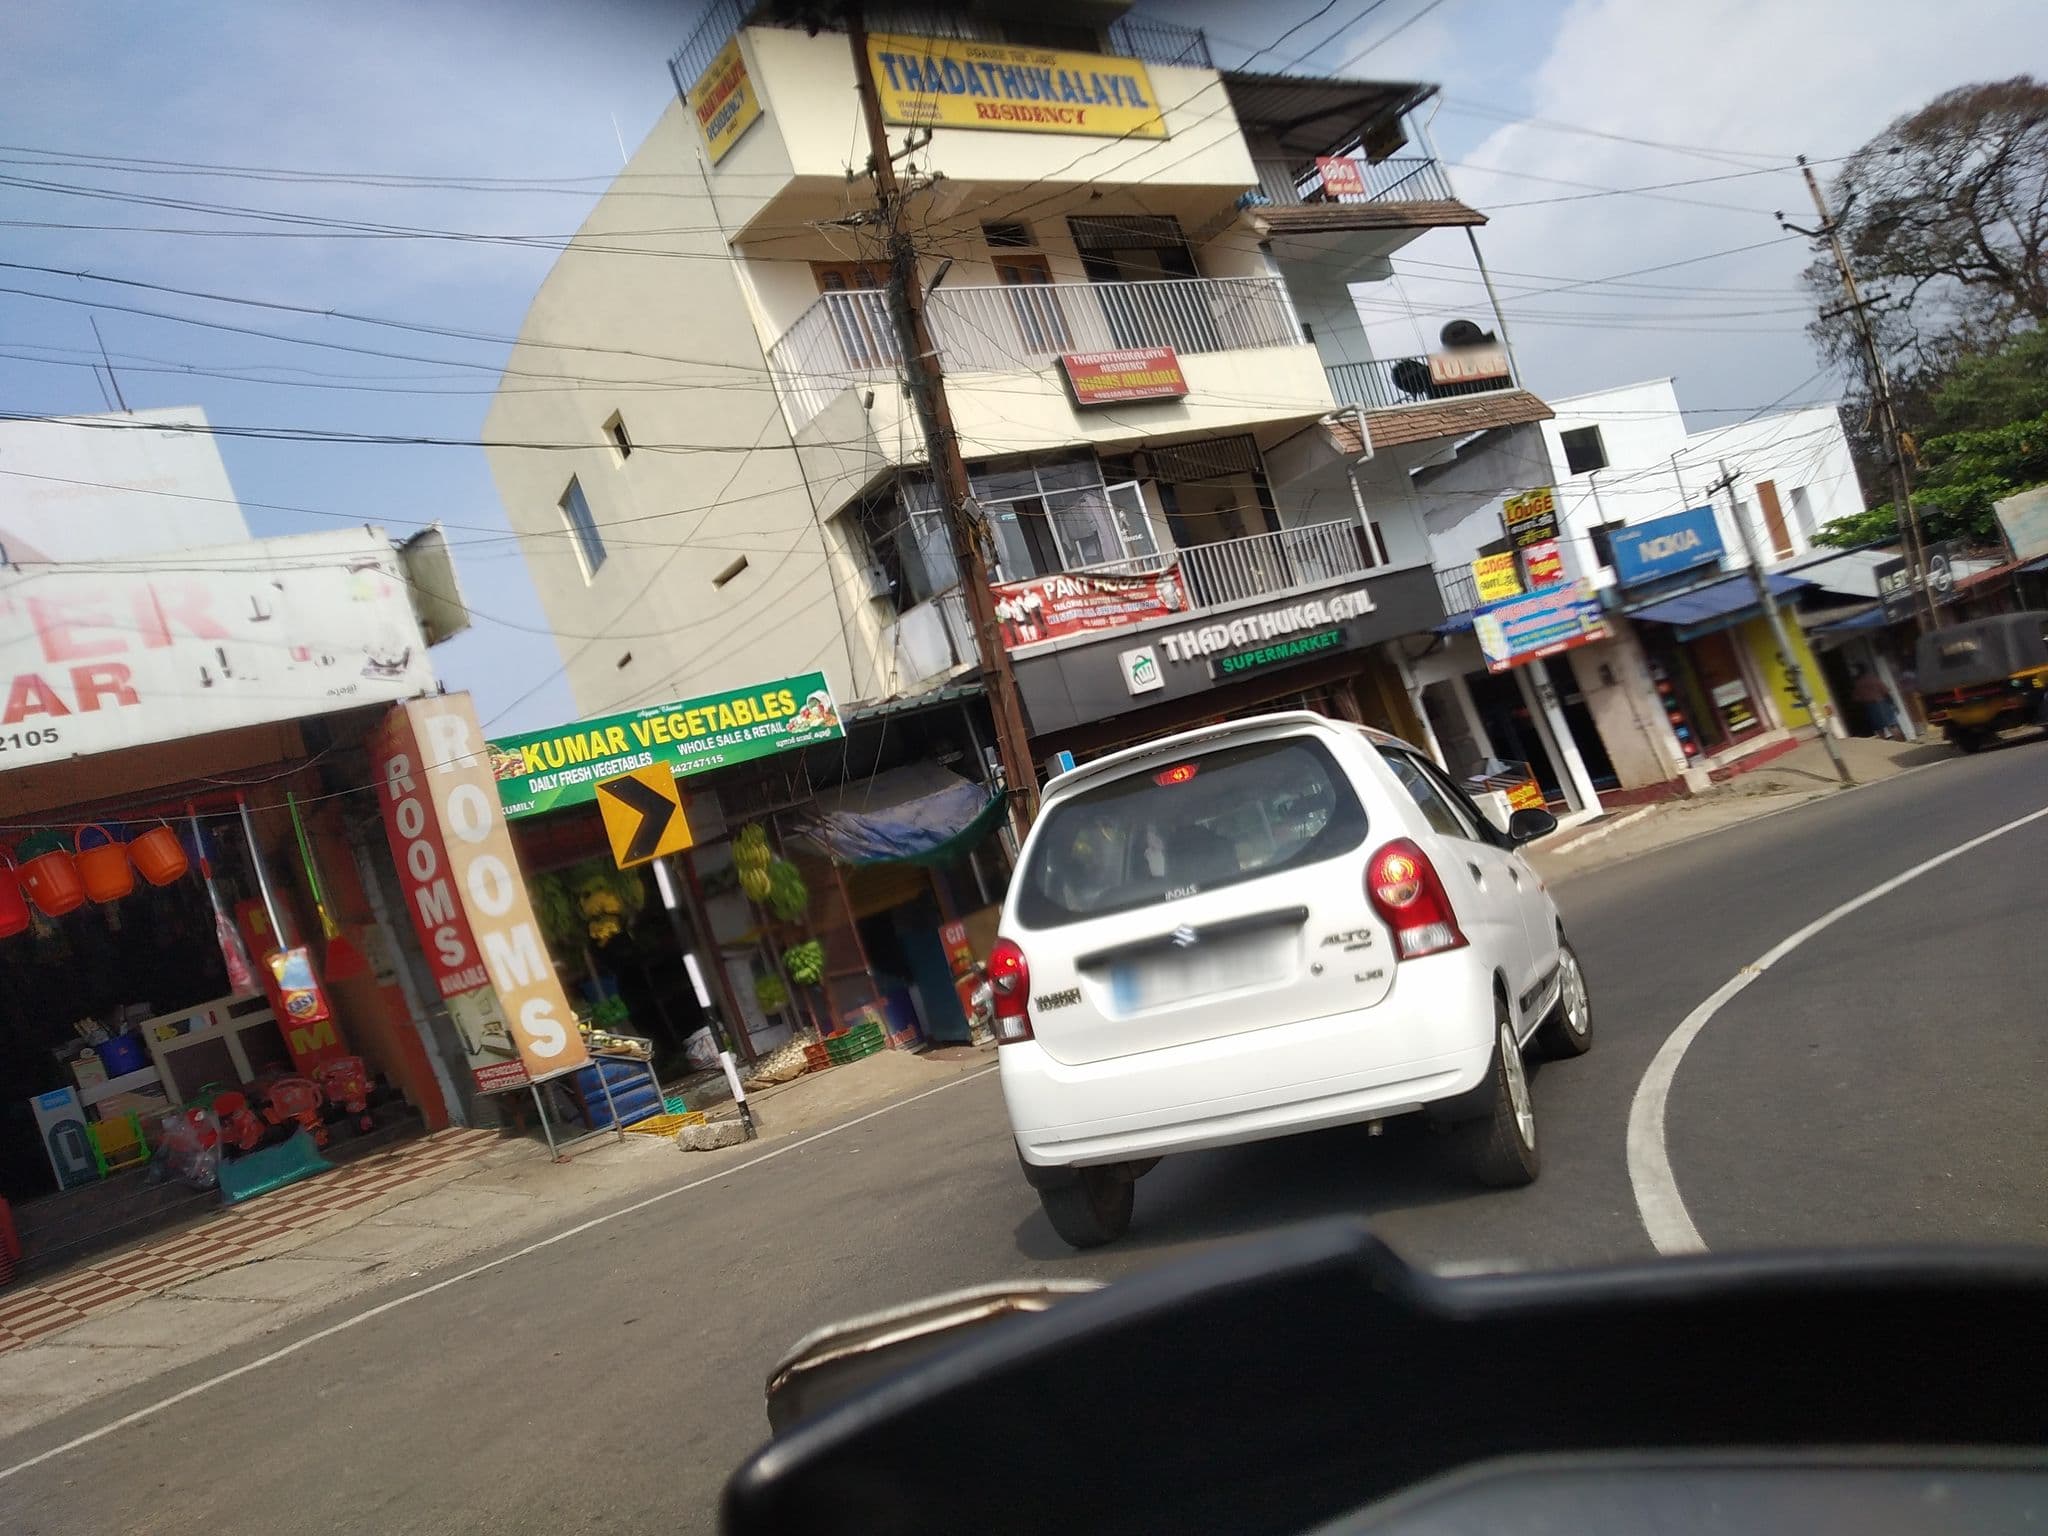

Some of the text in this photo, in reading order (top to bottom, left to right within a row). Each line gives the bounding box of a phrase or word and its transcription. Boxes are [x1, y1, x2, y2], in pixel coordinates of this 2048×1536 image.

[878, 53, 1149, 108] THADATHUKALAYIL
[975, 102, 1087, 125] RESIDENCY
[1072, 349, 1168, 365] THADATHUKALAYIL
[1099, 360, 1149, 373] RESIDENCY
[1076, 374, 1122, 392] ROOMS
[1122, 369, 1181, 389] AVAILABLE
[1506, 494, 1554, 523] LODGE
[1639, 529, 1702, 563] NOKIA
[1042, 576, 1091, 602] PANT
[1159, 589, 1377, 663] THADATHUKALAYIL
[1222, 631, 1340, 673] SUPERMARKET
[519, 688, 797, 775] KUMAR VEGETABLES
[676, 723, 786, 756] WHOLE SALE & RETAIL
[528, 751, 653, 794] DAILY FRESH VEGETABLES
[385, 753, 466, 967] ROOMS
[424, 713, 567, 1058] ROOMS
[1320, 928, 1372, 948] ALTO
